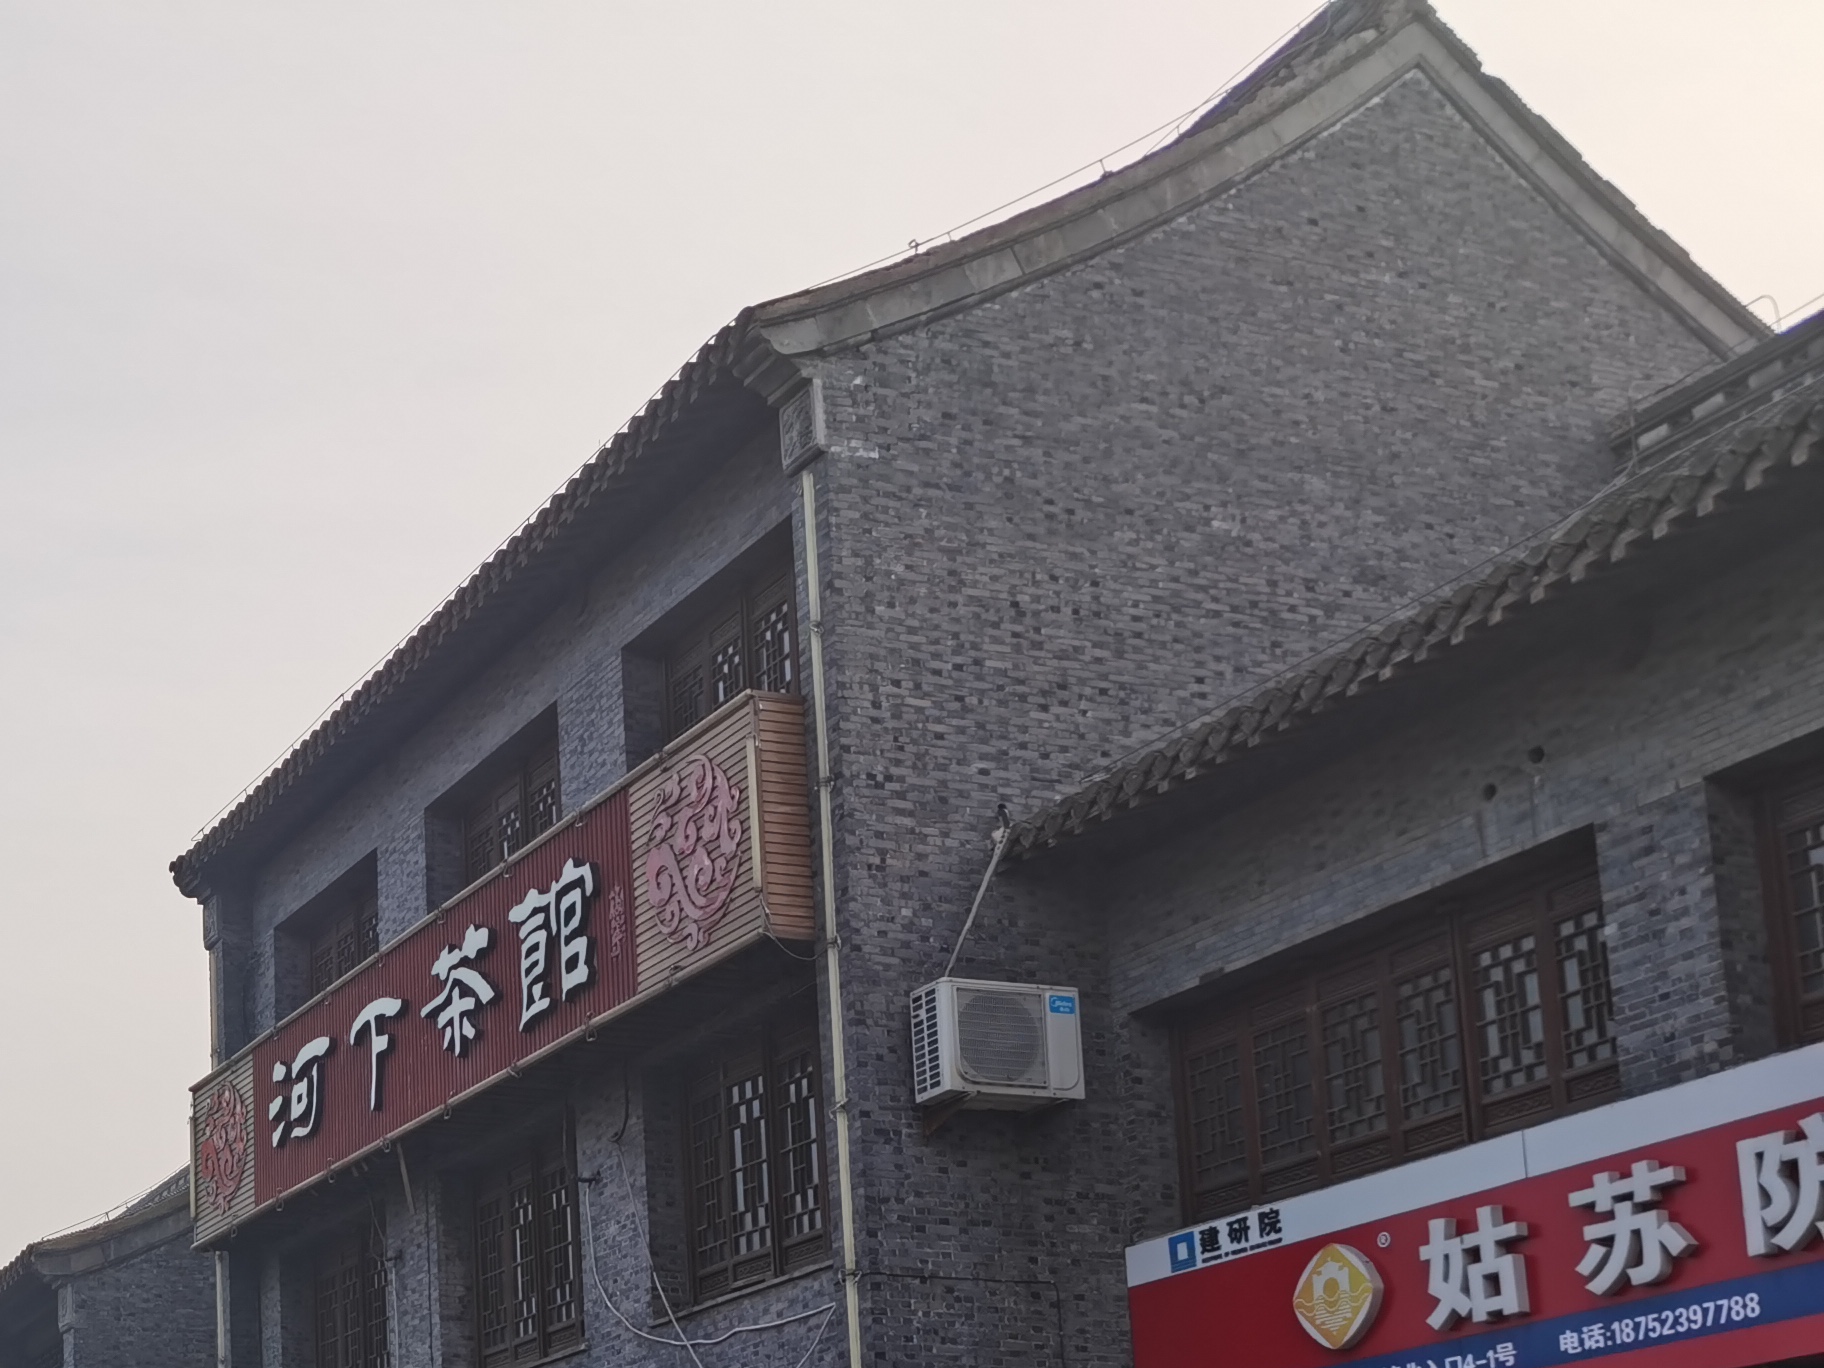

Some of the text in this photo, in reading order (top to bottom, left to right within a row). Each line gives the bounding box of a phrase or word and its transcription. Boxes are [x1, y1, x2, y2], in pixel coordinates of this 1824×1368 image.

[1199, 1207, 1283, 1255] 建研院
[1559, 1292, 1761, 1355] 电话:18752397788
